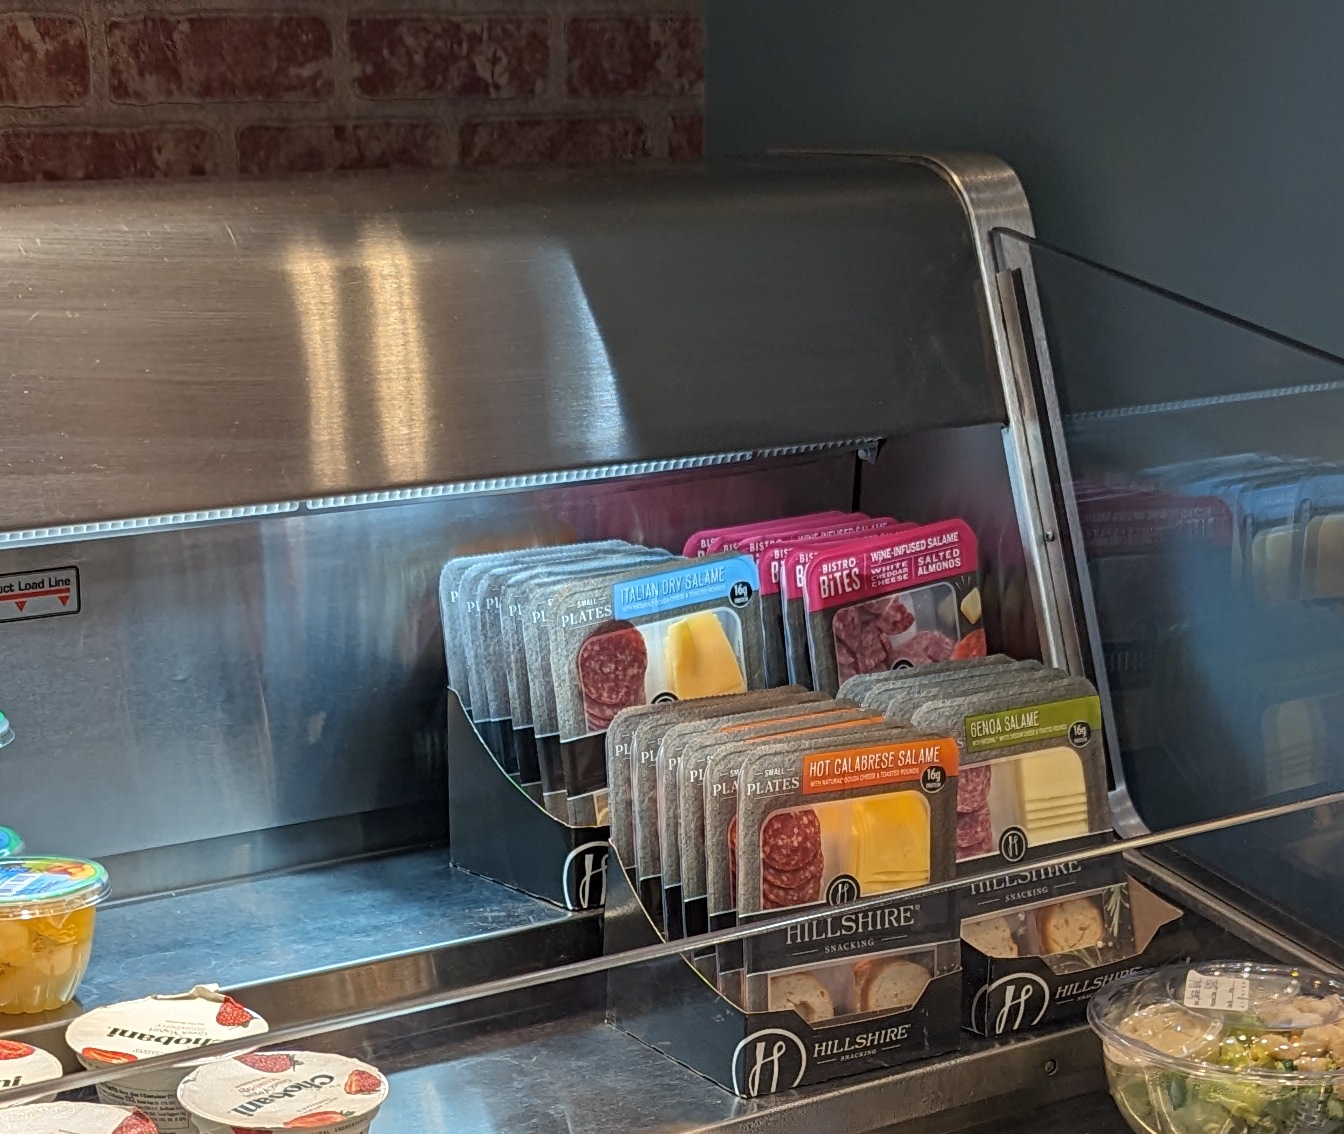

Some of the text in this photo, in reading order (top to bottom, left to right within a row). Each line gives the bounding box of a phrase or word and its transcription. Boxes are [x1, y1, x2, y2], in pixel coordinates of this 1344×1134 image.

[927, 531, 959, 549] SALAME
[917, 548, 960, 565] SALTED
[822, 558, 856, 574] BISTRO
[871, 561, 908, 574] WHITE
[917, 558, 961, 576] ALMONDS
[871, 568, 909, 581] CHEDDAR
[871, 574, 909, 588] CHEESE
[18, 579, 44, 591] Load
[49, 577, 70, 587] Line
[621, 583, 659, 605] ITALIAN
[662, 577, 683, 595] DRY
[685, 566, 726, 590] SALAME
[734, 584, 748, 597] 16g
[577, 598, 597, 608] SMALL
[561, 605, 612, 627] PLATES
[970, 718, 1002, 738] GENOA
[1004, 711, 1039, 731] SALAME
[809, 746, 941, 777] HOT CALABRESE SALAME
[764, 768, 785, 778] SMALL
[926, 768, 941, 782] 16g
[746, 777, 800, 796] PLATES
[1004, 886, 1049, 903] SNACKING
[785, 904, 915, 945] HILLSHIRE
[824, 938, 875, 954] SNACKING
[813, 1025, 909, 1059] HILLSHIRE
[840, 1048, 877, 1063] SNACKING
